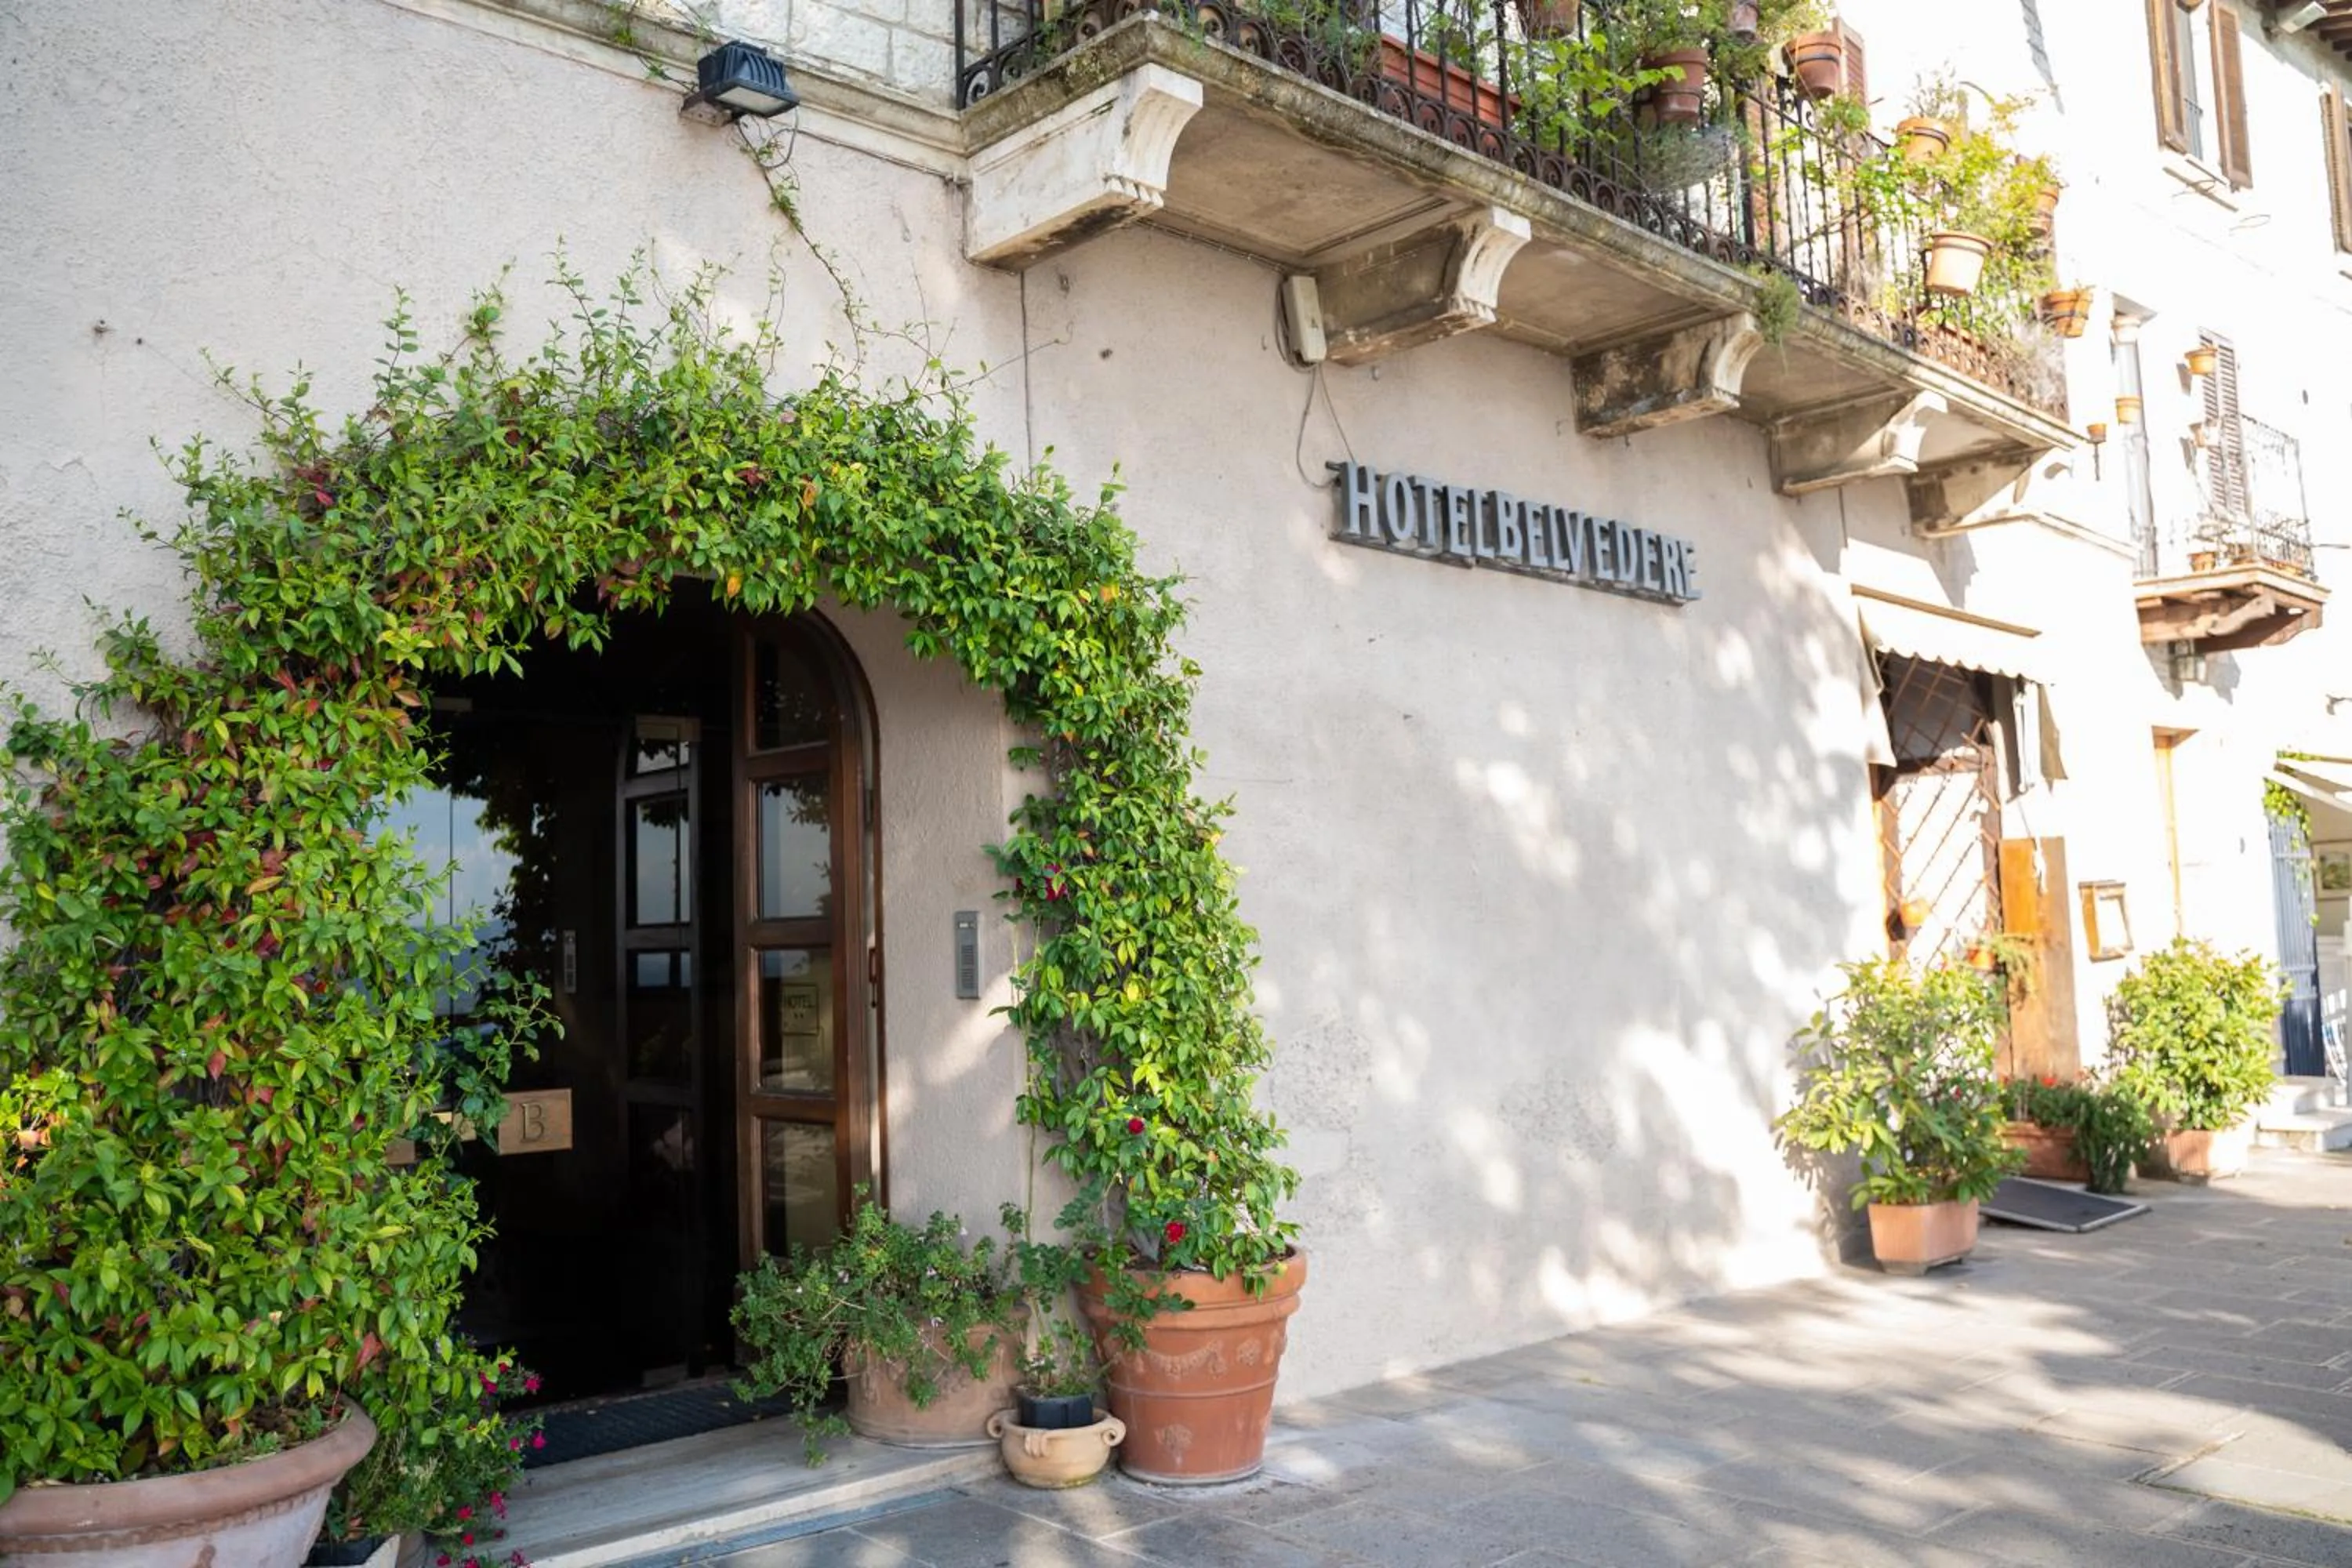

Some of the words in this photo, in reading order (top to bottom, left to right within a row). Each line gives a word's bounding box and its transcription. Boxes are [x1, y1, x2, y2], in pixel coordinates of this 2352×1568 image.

[1342, 461, 1496, 560] HOTEL
[1493, 490, 1703, 601] BELVEDERE
[521, 1101, 546, 1143] B
